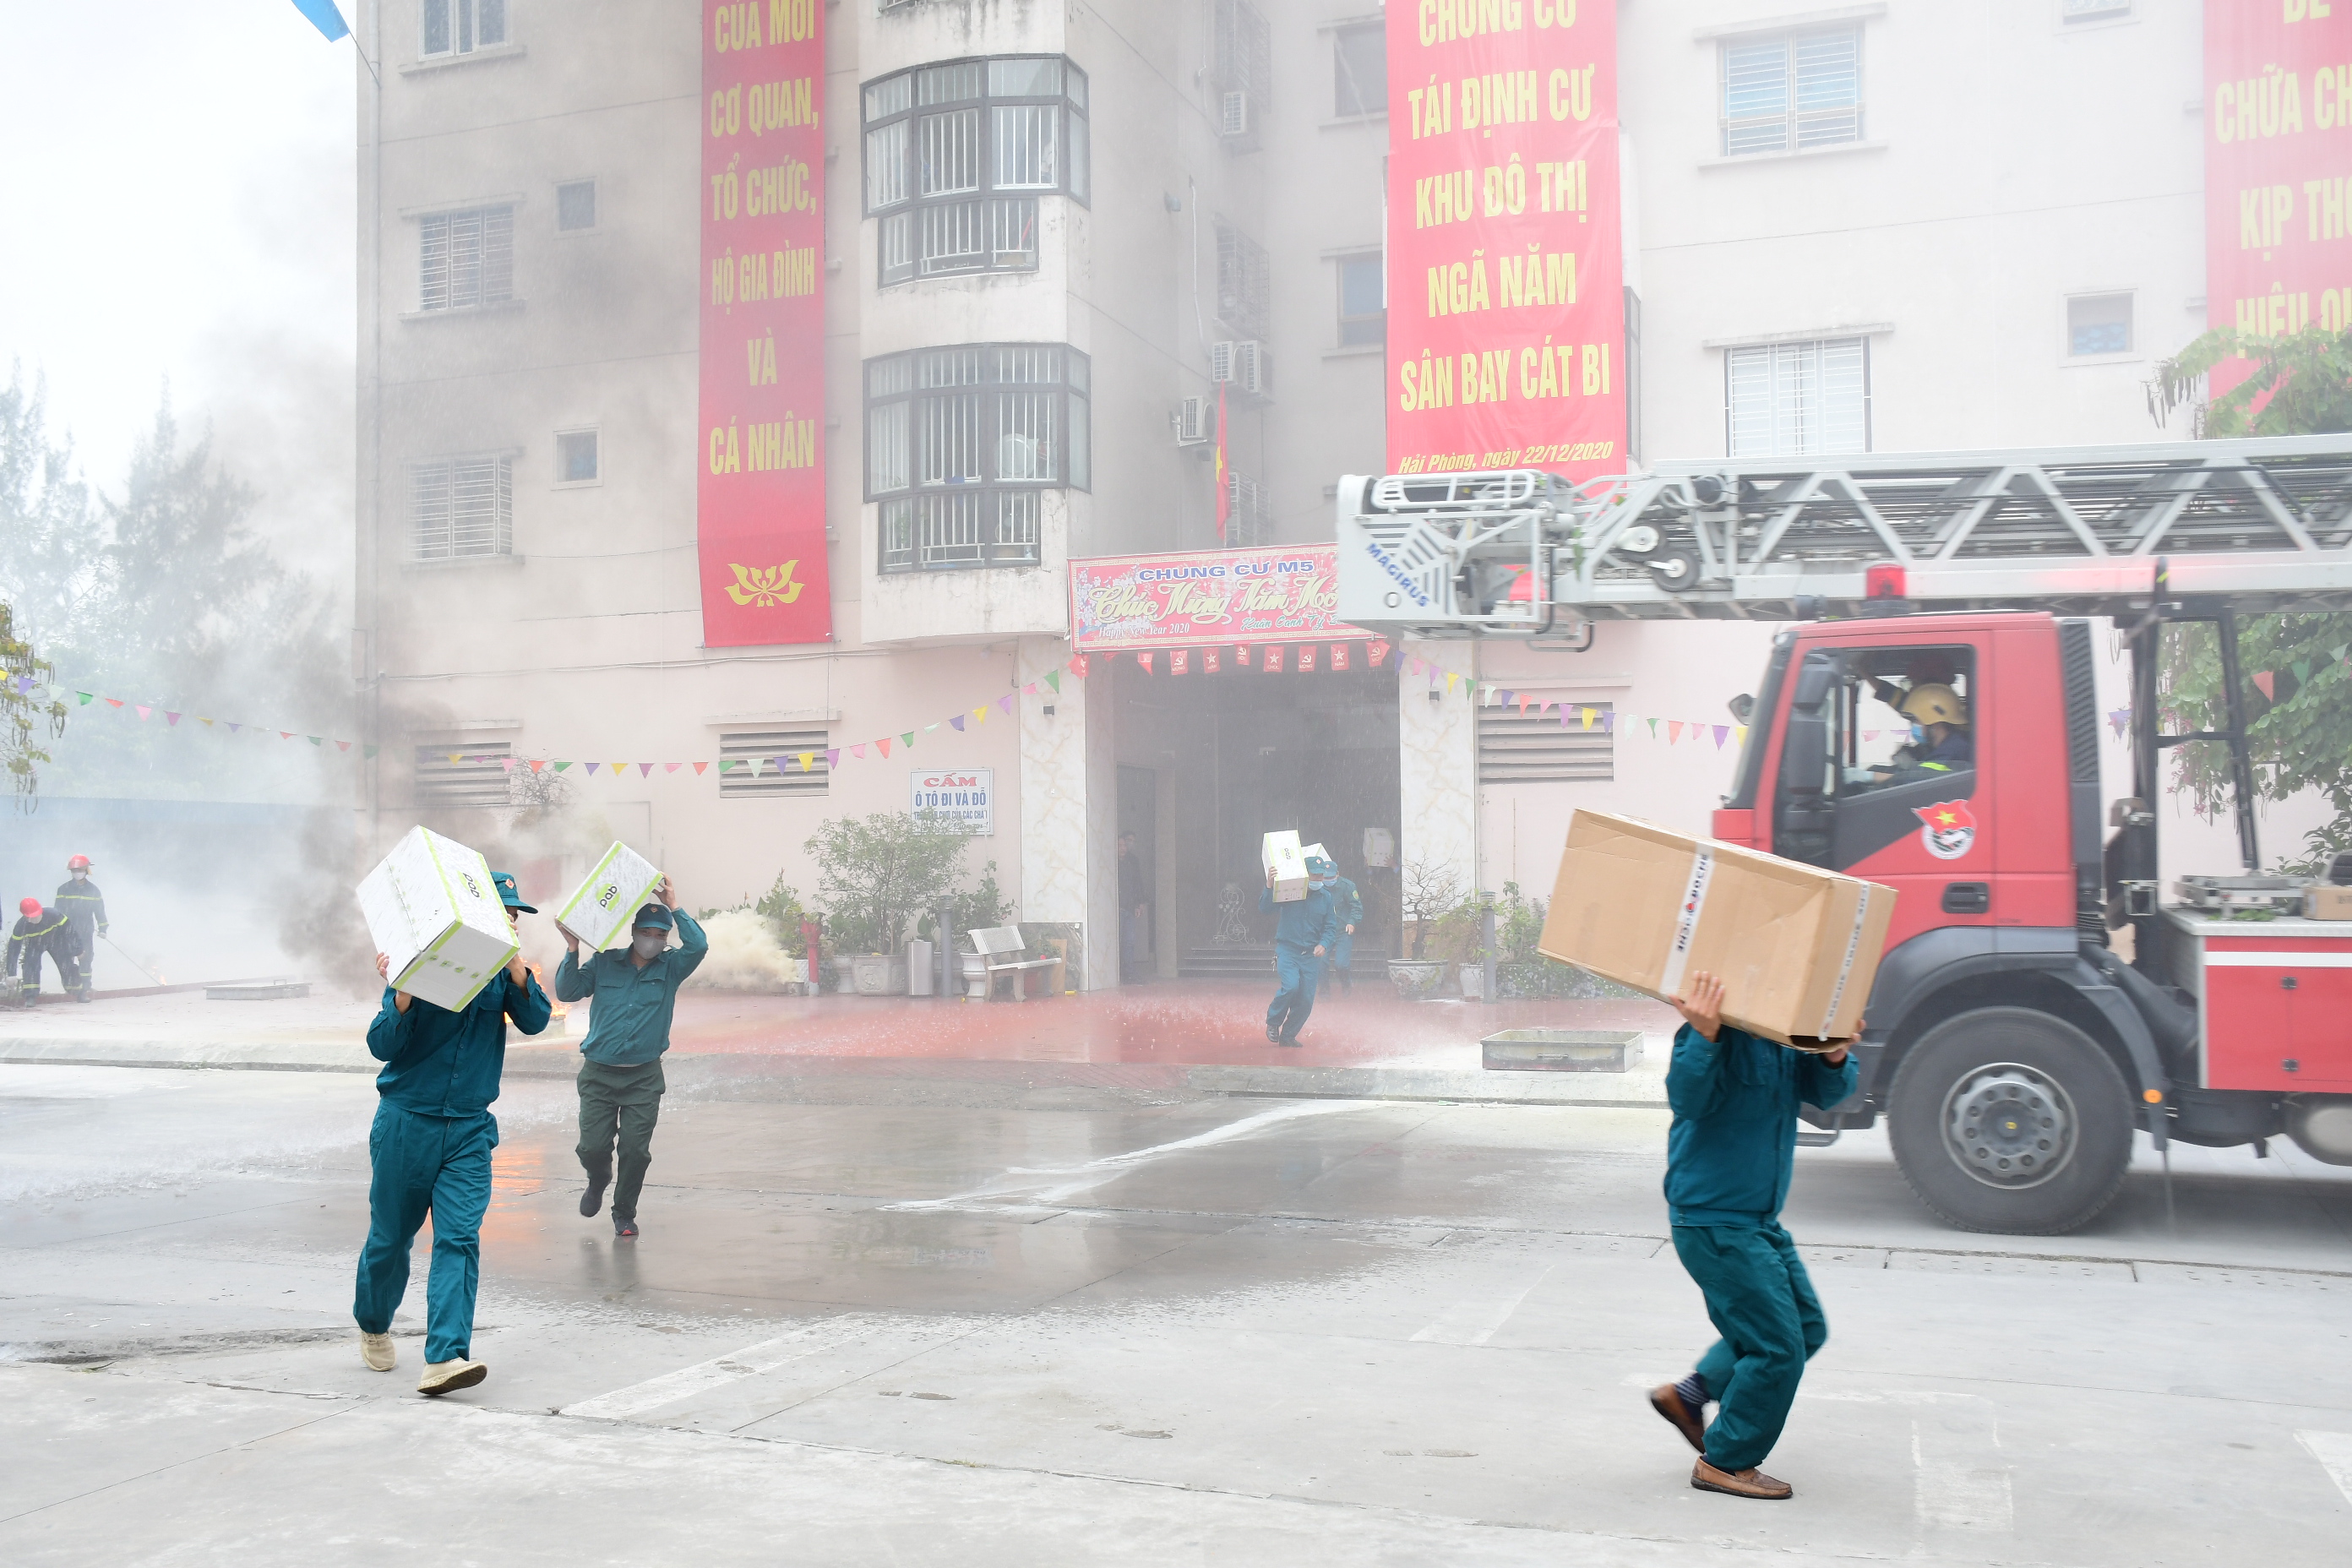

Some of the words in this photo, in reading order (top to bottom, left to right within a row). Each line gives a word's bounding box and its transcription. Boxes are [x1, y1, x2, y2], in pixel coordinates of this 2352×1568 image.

[710, 83, 742, 138] CƠ
[749, 78, 819, 137] QUAN,
[1407, 74, 1451, 140] TÁI
[1461, 70, 1538, 139] ĐỊNH
[1549, 63, 1595, 122] CƯ
[2214, 63, 2303, 144] CHỮA
[710, 152, 740, 221] TỔ
[746, 155, 816, 217] CHỨC,
[1416, 170, 1473, 230] KHU
[1483, 152, 1526, 218] ĐÔ
[1536, 160, 1587, 223] THỊ
[2240, 184, 2293, 262] KỊP
[711, 247, 734, 315] HỘ
[739, 253, 768, 303] GIA
[773, 240, 815, 298] ĐÌNH
[1428, 248, 1490, 318] NGÃ
[1500, 242, 1576, 308] NĂM
[747, 327, 778, 386] VÀ
[1400, 348, 1453, 412] SÂN
[1461, 349, 1511, 405] BAY
[1520, 335, 1573, 400] CÁT
[1582, 343, 1610, 396] BI
[709, 415, 741, 476] CÁ
[748, 410, 814, 472] NHÂN
[1398, 453, 1427, 474] Hải
[1427, 452, 1477, 472] Phòng,
[1481, 447, 1522, 468] ngày
[1522, 441, 1614, 465] 22/12/2020
[1089, 585, 1159, 623] Chúc
[1233, 578, 1290, 612] Năm
[1139, 566, 1226, 581] CHUNG
[1234, 562, 1270, 575] CƯ
[1277, 561, 1314, 573] M5
[1367, 542, 1430, 607] MAGIRUS
[1098, 626, 1126, 640] Happy
[1130, 625, 1147, 635] New
[1149, 625, 1168, 635] Year
[1169, 623, 1190, 634] 2020
[915, 790, 923, 807] Ô
[925, 790, 939, 807] TÔ
[941, 792, 952, 807] ĐI
[956, 789, 969, 806] VÀ
[972, 787, 987, 806] ĐỖ
[923, 772, 977, 787] CẤM
[962, 808, 973, 819] CÁC
[600, 885, 618, 908] pab
